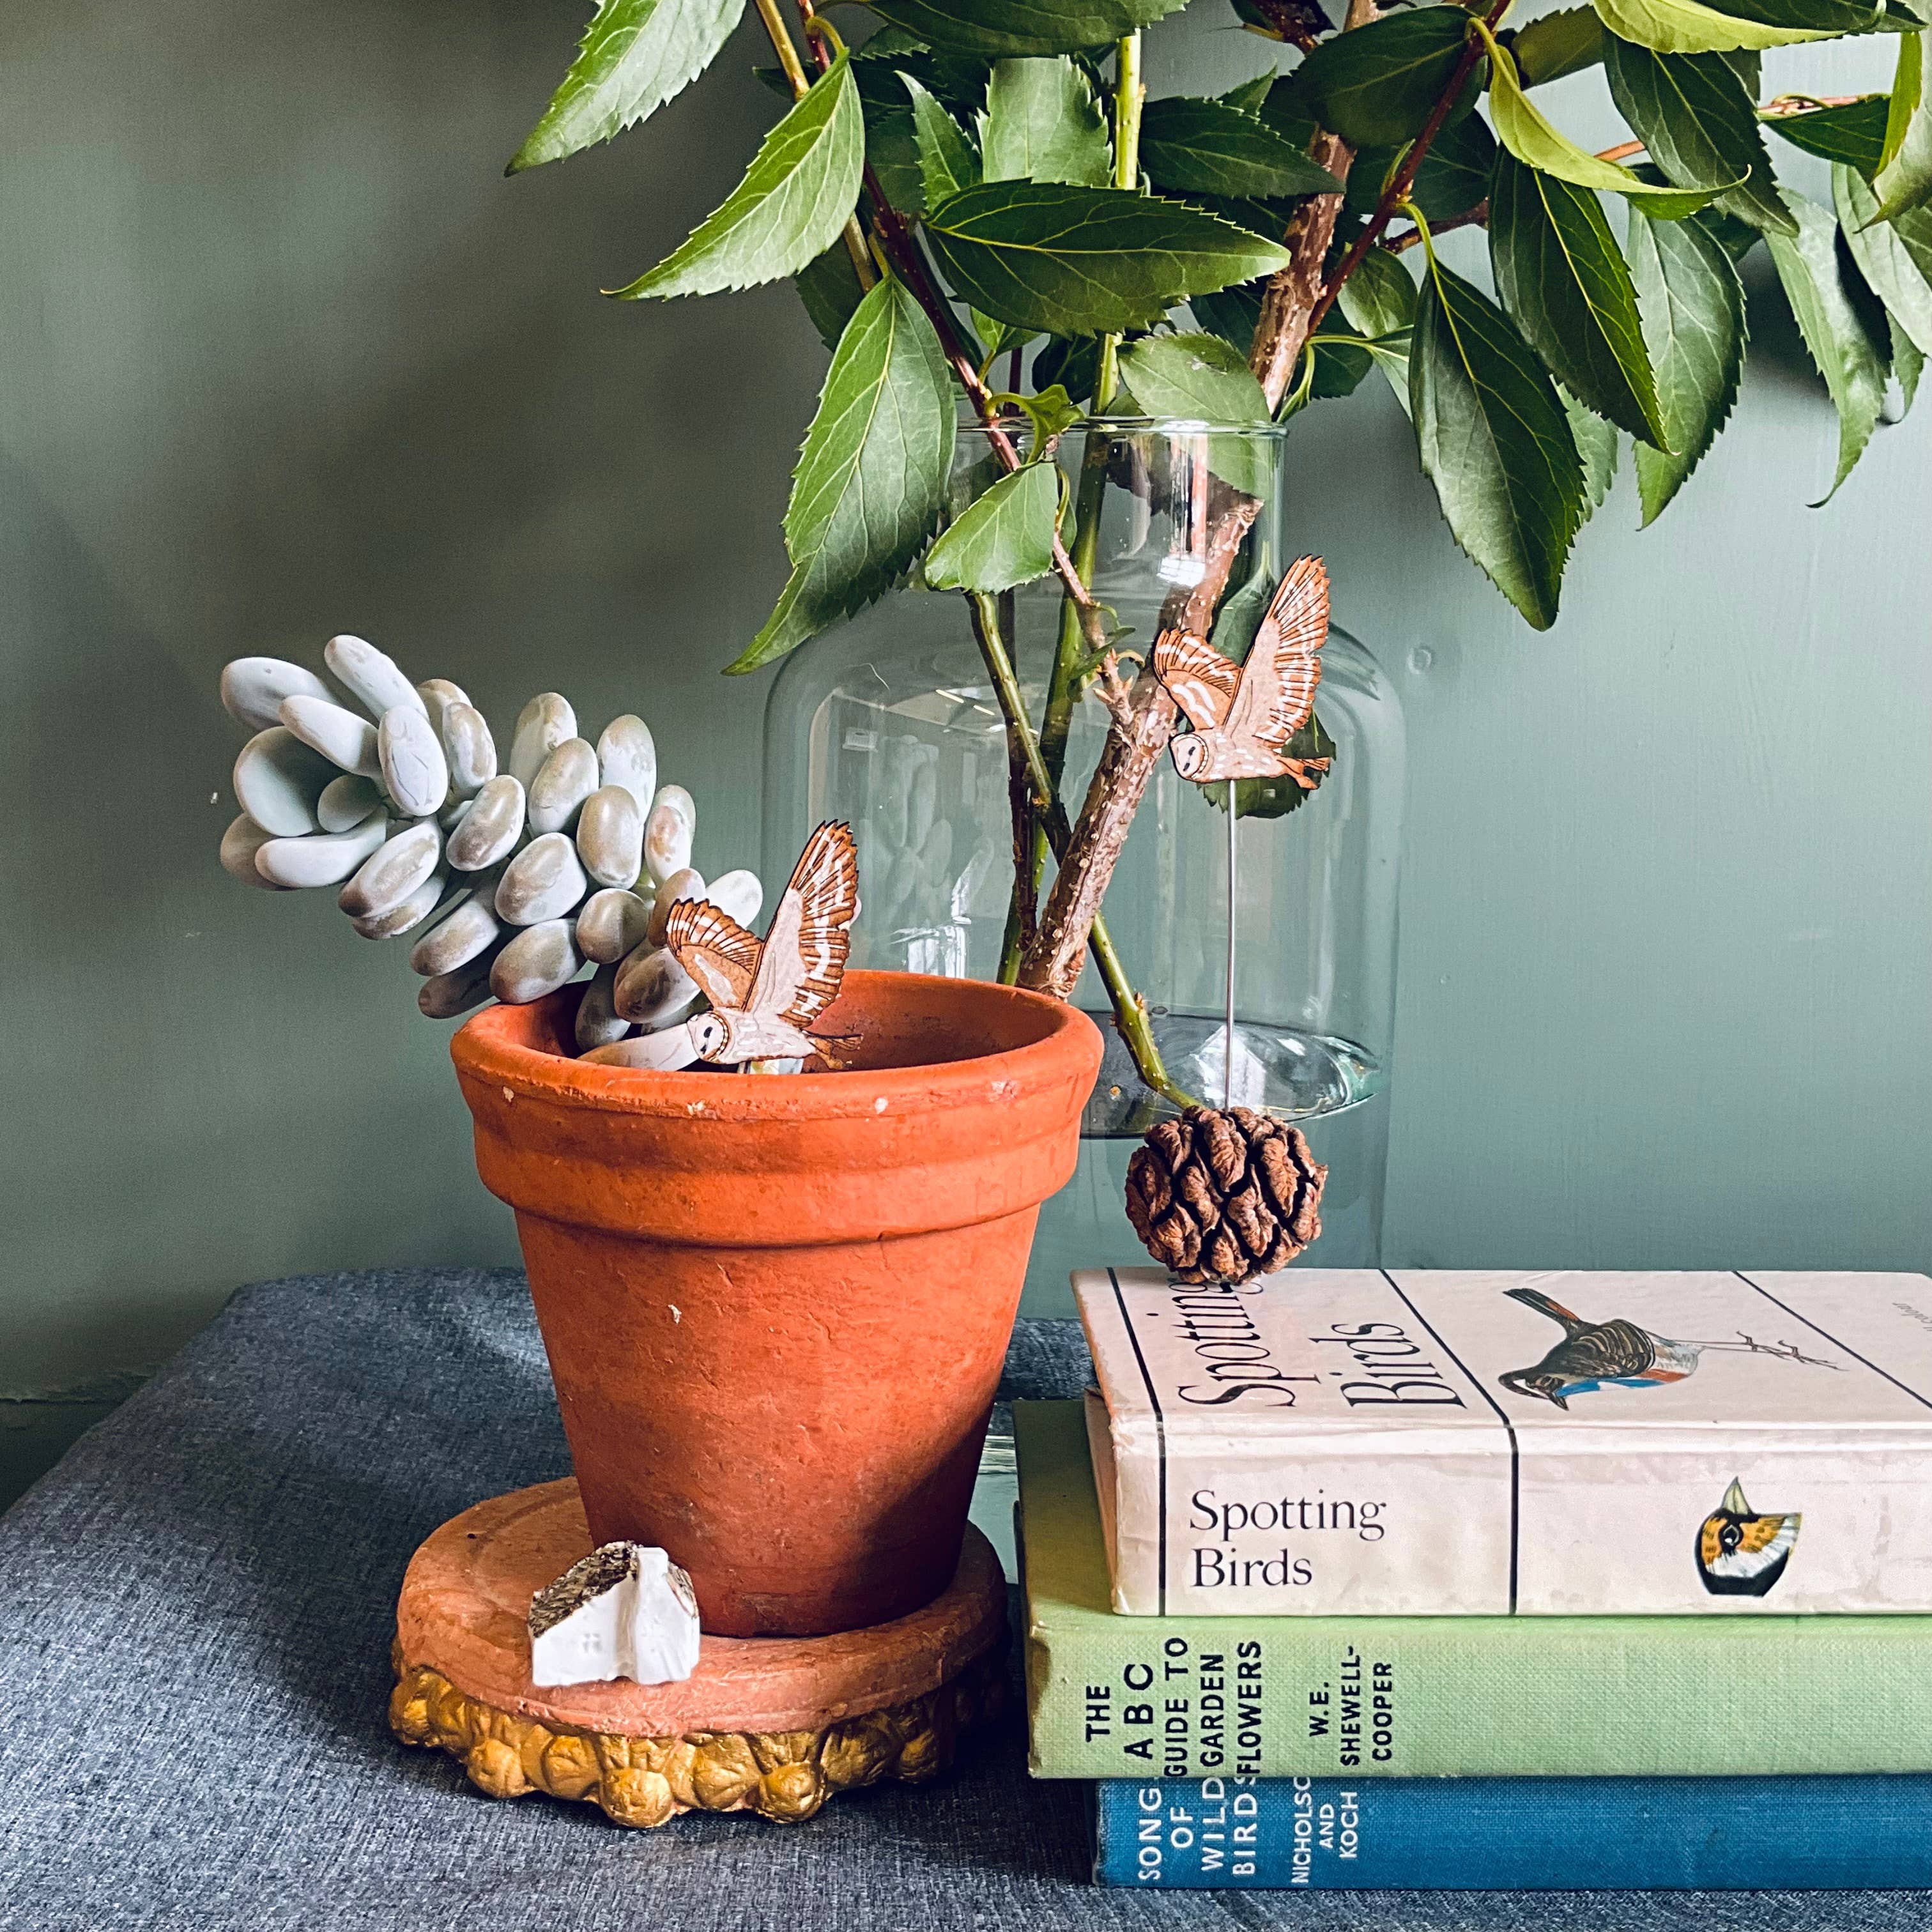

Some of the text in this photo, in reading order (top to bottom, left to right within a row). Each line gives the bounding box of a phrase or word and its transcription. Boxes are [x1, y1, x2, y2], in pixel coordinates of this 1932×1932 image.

[1307, 1322, 1468, 1409] Birds
[1189, 1490, 1387, 1542] Spotting
[1192, 1547, 1313, 1587] Birds
[1085, 1685, 1110, 1743] THE
[1163, 1637, 1189, 1777] GUIDE TO
[1199, 1654, 1225, 1767] GARDEN
[1236, 1640, 1262, 1774] FLOWERS
[1340, 1646, 1361, 1767] SHEWELL-
[1372, 1662, 1393, 1761] COOPER
[1137, 1777, 1162, 1881] SONG
[1170, 1806, 1193, 1848] OF
[1201, 1777, 1225, 1871] WILD
[1291, 1777, 1313, 1884] NICHOLSO
[1319, 1803, 1335, 1849] AND
[1338, 1791, 1360, 1859] KOCH
